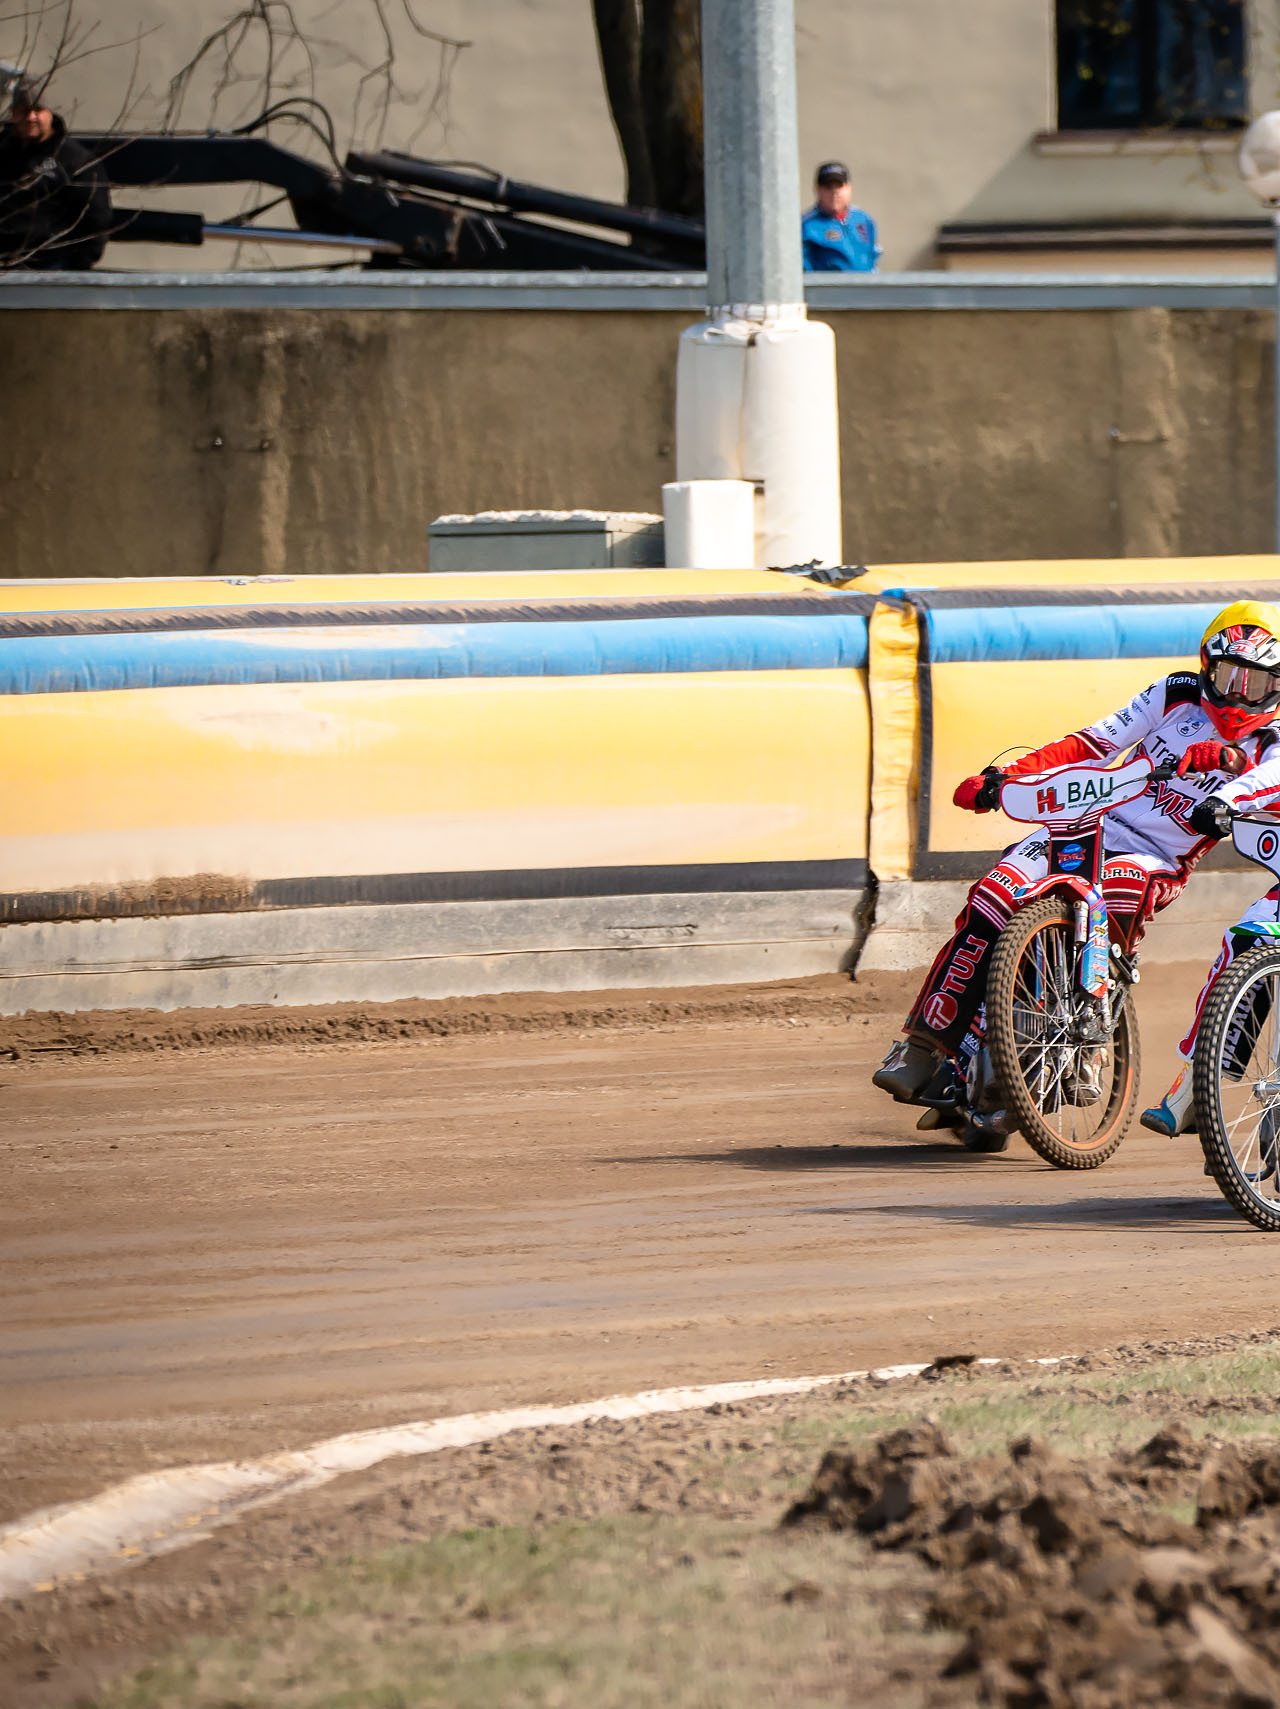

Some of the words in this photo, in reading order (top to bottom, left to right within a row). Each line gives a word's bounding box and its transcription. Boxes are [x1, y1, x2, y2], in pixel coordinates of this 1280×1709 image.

[1167, 676, 1198, 687] Trans
[1068, 776, 1113, 803] BAU
[940, 934, 989, 993] TULI
